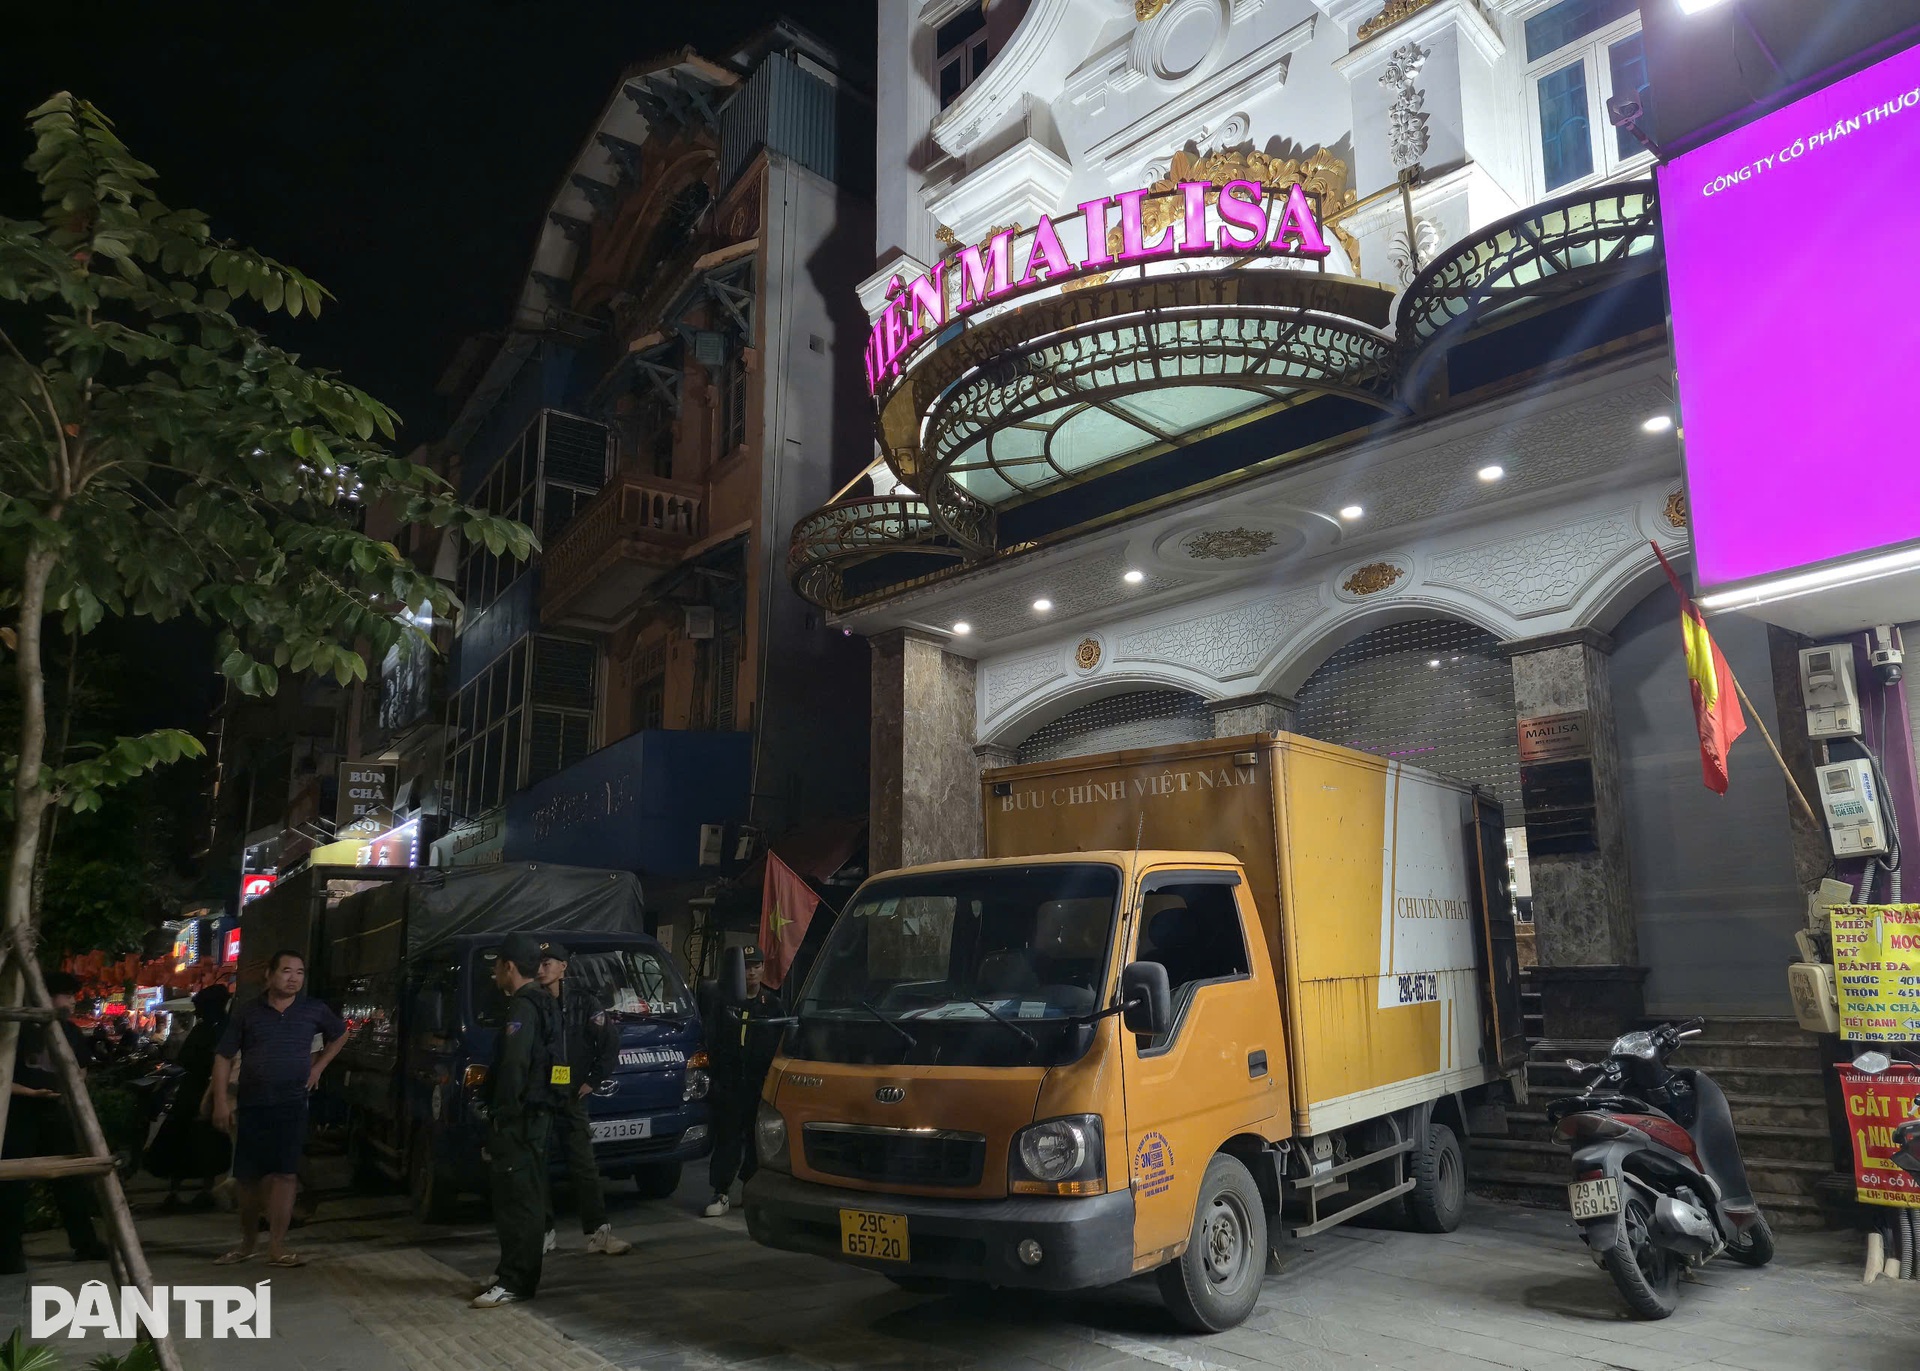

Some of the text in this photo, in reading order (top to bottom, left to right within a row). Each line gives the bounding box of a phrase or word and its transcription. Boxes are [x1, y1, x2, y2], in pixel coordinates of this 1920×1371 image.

[1702, 166, 1752, 196] CÔNG
[1752, 154, 1776, 175] TY
[864, 180, 1330, 396] VIỆN MAILISA
[1525, 723, 1580, 739] MAILISA
[349, 770, 386, 783] BÚN
[1051, 779, 1127, 806] CHÍNH
[1133, 769, 1191, 798] VIỆT
[1197, 766, 1256, 791] NAM
[349, 785, 385, 800] CHẢ
[1397, 889, 1470, 920] CHUYỂN PHÁT
[1835, 917, 1874, 929] MIẾN
[1836, 931, 1920, 953] PHỞ MỌC
[1838, 961, 1911, 971] BÁNH ĐA
[1399, 974, 1438, 1003] 29C-657.20
[1842, 974, 1879, 984] NƯỚC
[1844, 988, 1879, 999] TRỘN
[1847, 1003, 1886, 1012] NGAN
[1844, 1015, 1864, 1027] TIẾT
[1867, 1018, 1897, 1028] CANH
[1850, 1087, 1891, 1118] CẮT
[1575, 1180, 1612, 1199] 29-M1
[1861, 1173, 1881, 1186] GỘI
[1888, 1174, 1905, 1187] CỔ
[1574, 1196, 1619, 1217] 569.45
[859, 1213, 887, 1234] 29C
[848, 1234, 900, 1258] 657.20
